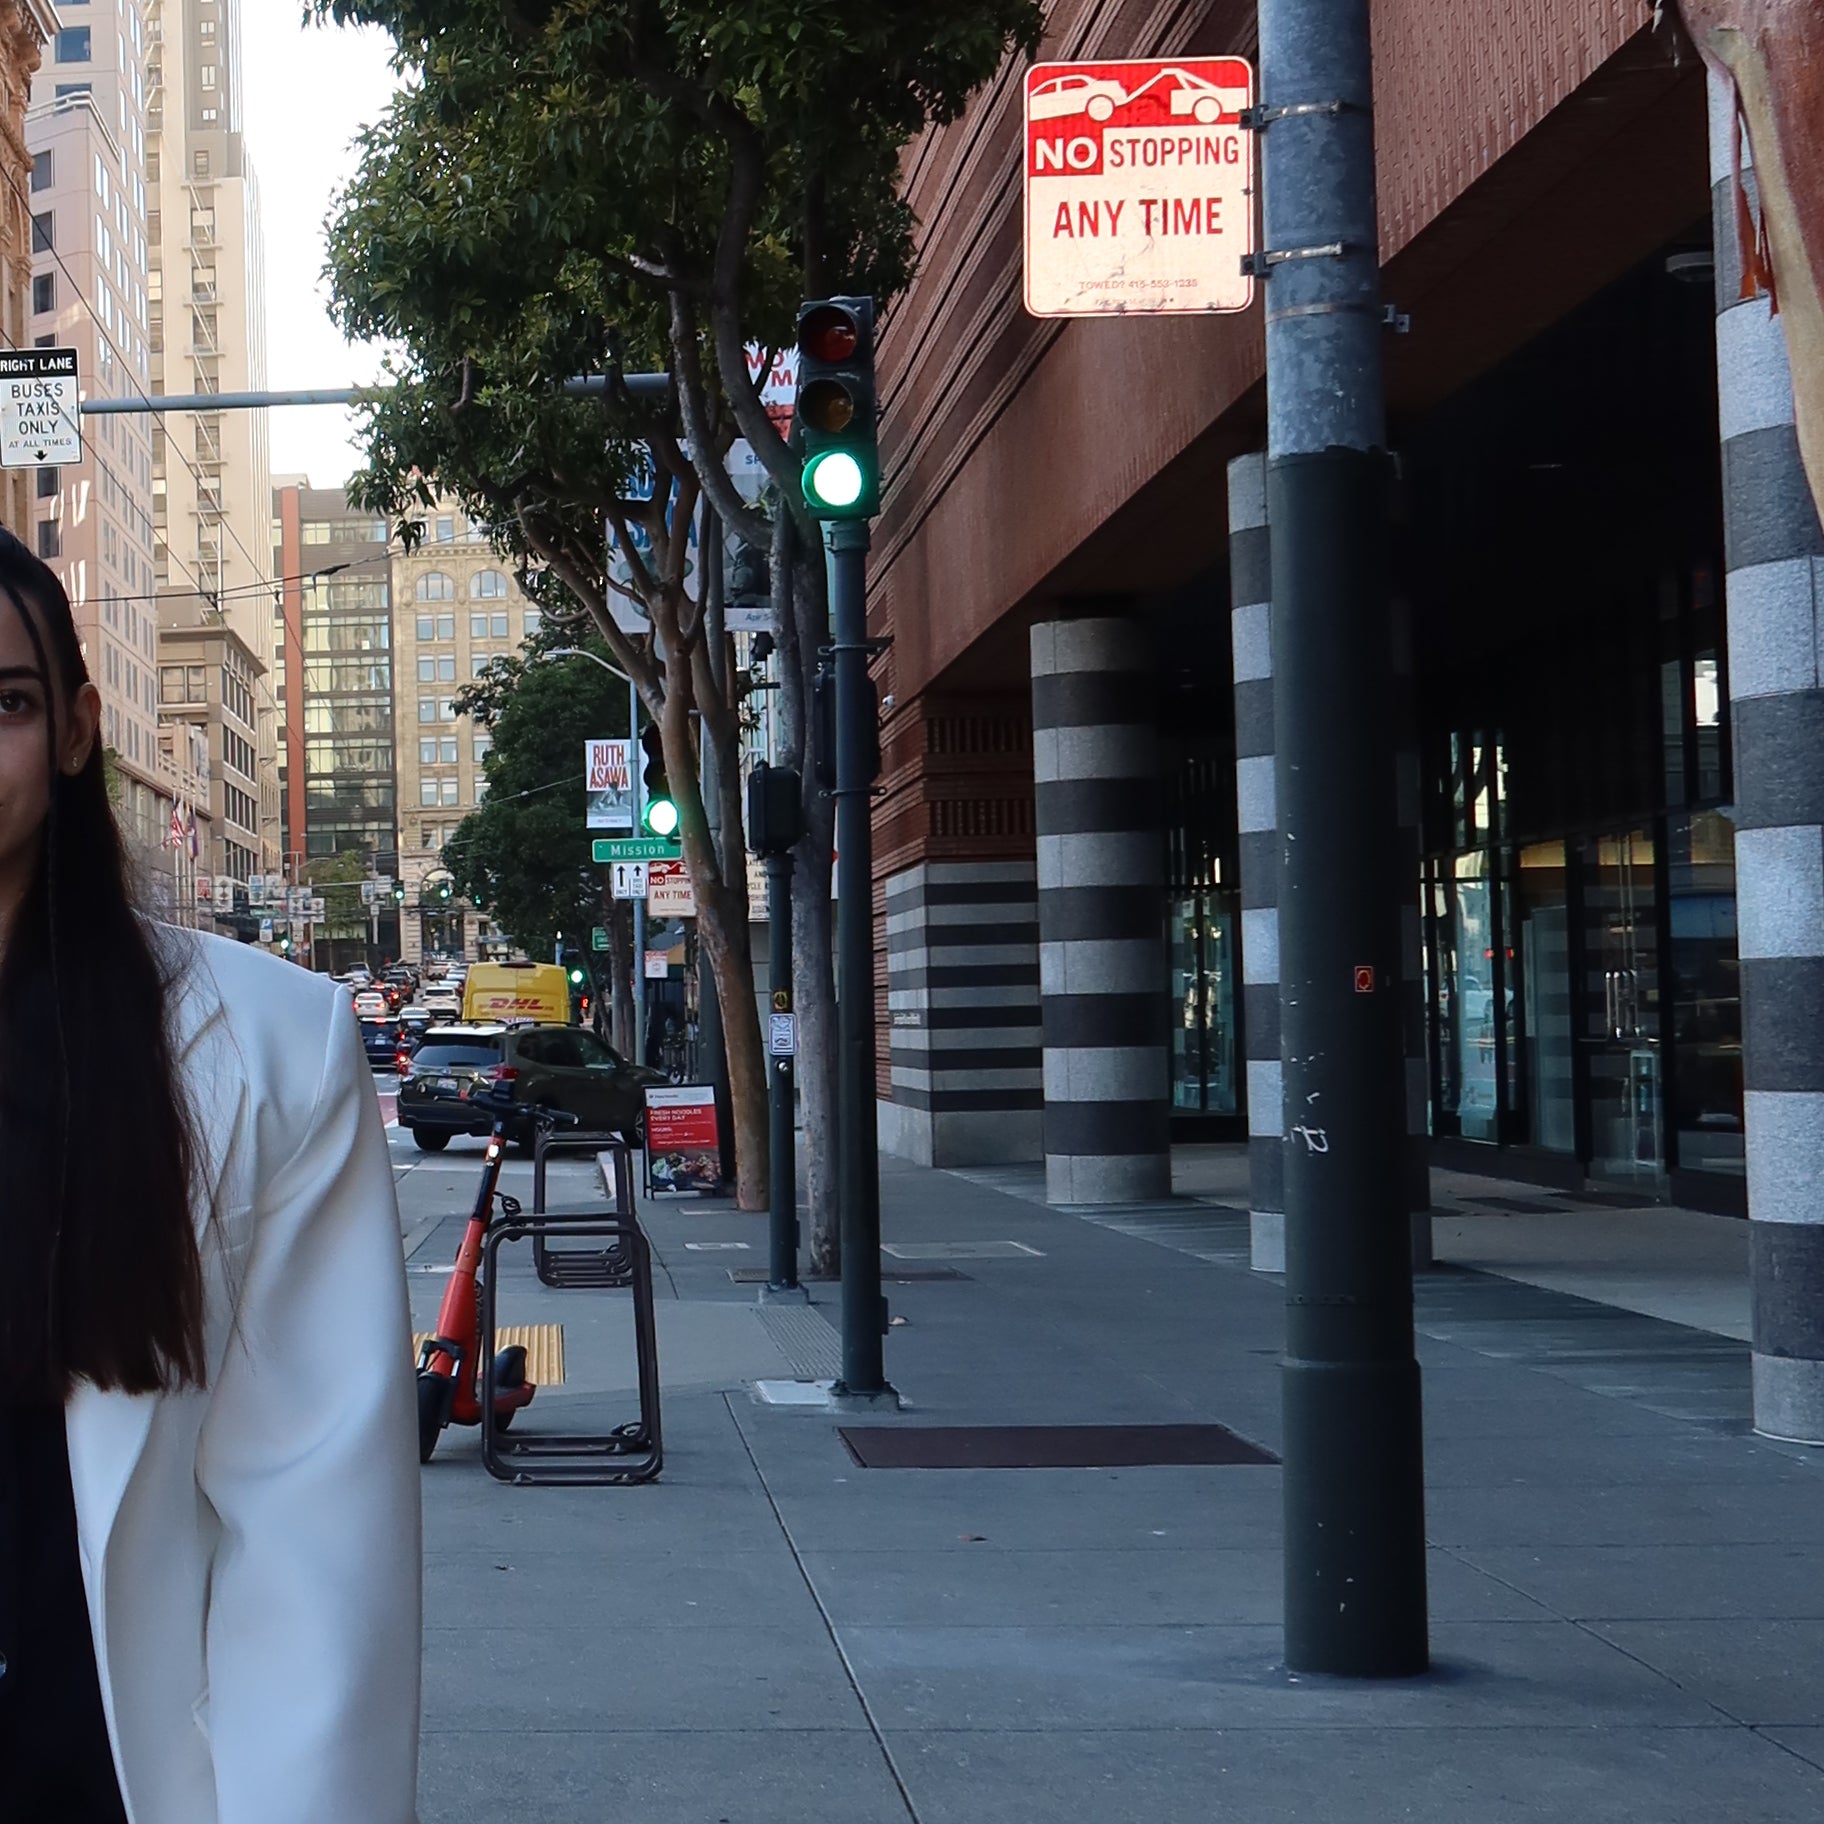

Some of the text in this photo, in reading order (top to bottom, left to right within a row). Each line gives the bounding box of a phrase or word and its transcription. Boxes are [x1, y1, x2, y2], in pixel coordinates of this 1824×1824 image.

[1035, 136, 1239, 170] NO STOPPING
[1052, 197, 1224, 239] ANY TIME
[0, 357, 74, 372] RIGHT LANE
[11, 382, 64, 399] BUSES
[17, 401, 60, 416] TAXIS
[18, 420, 58, 435] ONLY
[8, 437, 73, 449] AT ALL TIMES
[593, 744, 624, 766] RUTH
[589, 767, 629, 788] ASAWA
[611, 844, 665, 857] Mission
[666, 877, 691, 885] STOPPIN
[654, 890, 692, 900] ANY TIME
[489, 998, 544, 1010] DHL
